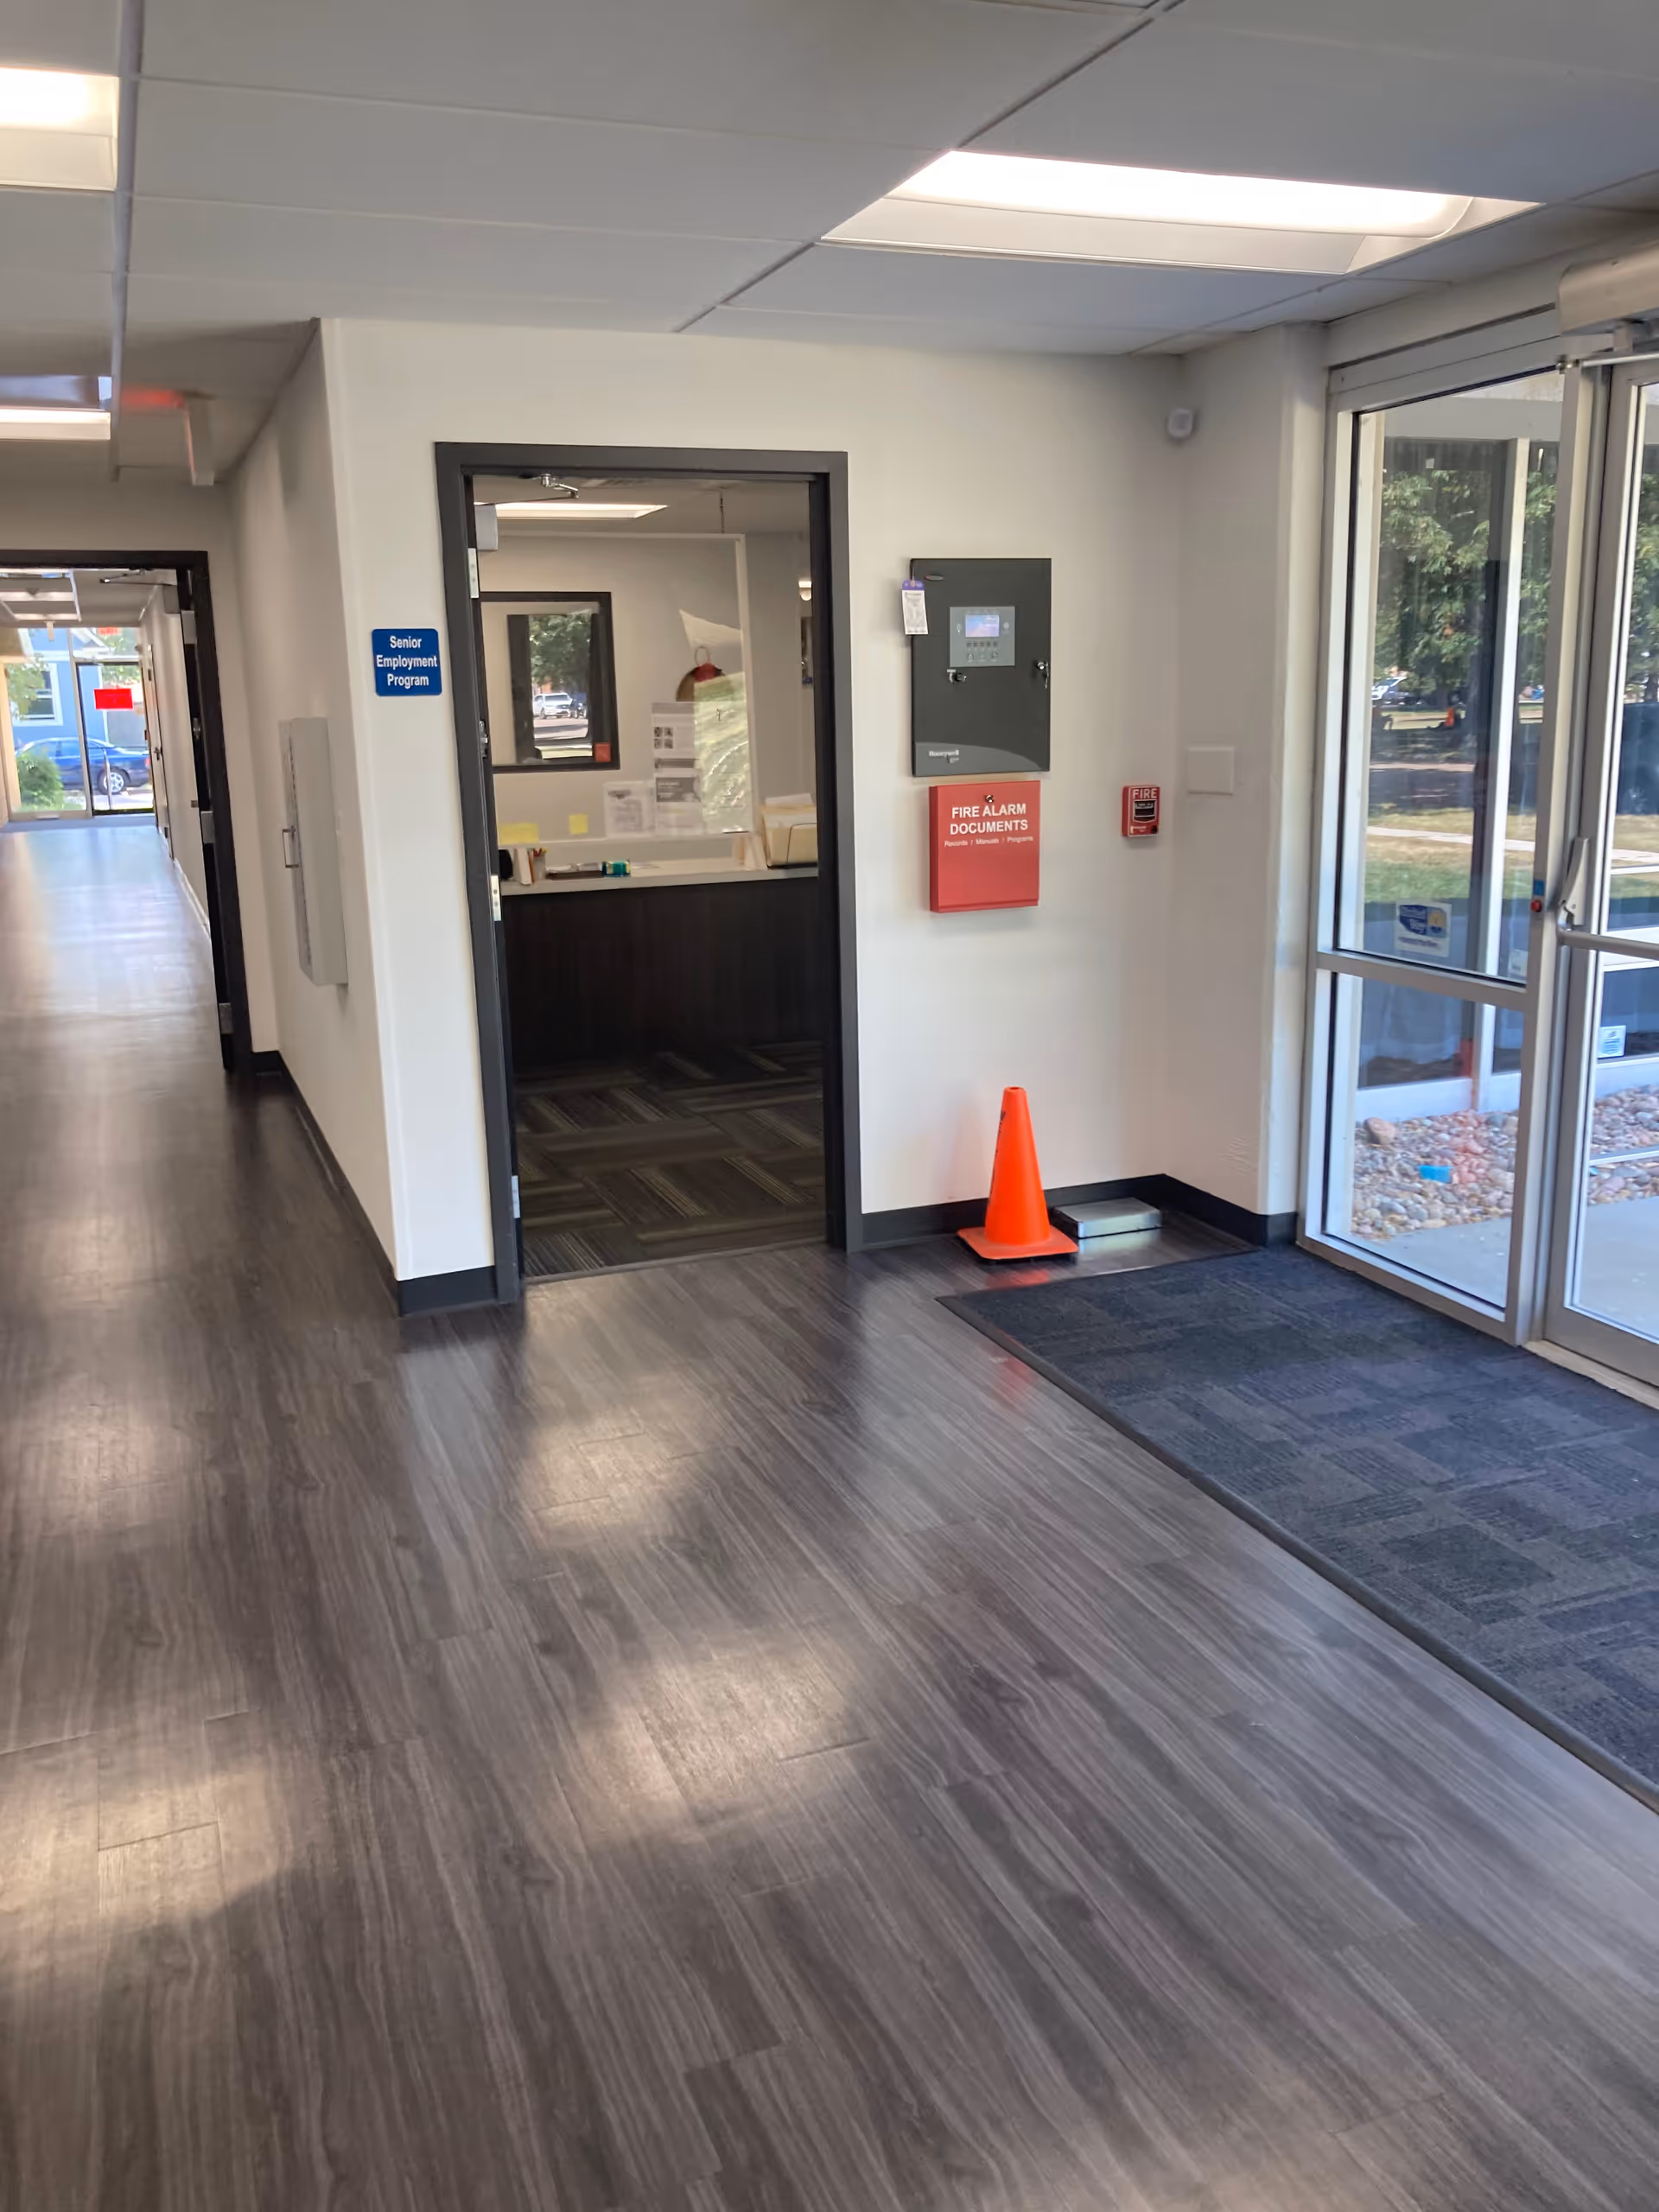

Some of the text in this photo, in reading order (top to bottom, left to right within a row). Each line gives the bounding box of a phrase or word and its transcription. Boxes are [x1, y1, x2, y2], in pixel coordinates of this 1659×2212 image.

[390, 635, 423, 649] Senior
[376, 654, 438, 671] Employment
[387, 673, 429, 689] Program
[1133, 788, 1158, 799] FIRE
[951, 804, 1027, 819] FIRE ALARM
[950, 819, 1028, 836] DOCUMENTS
